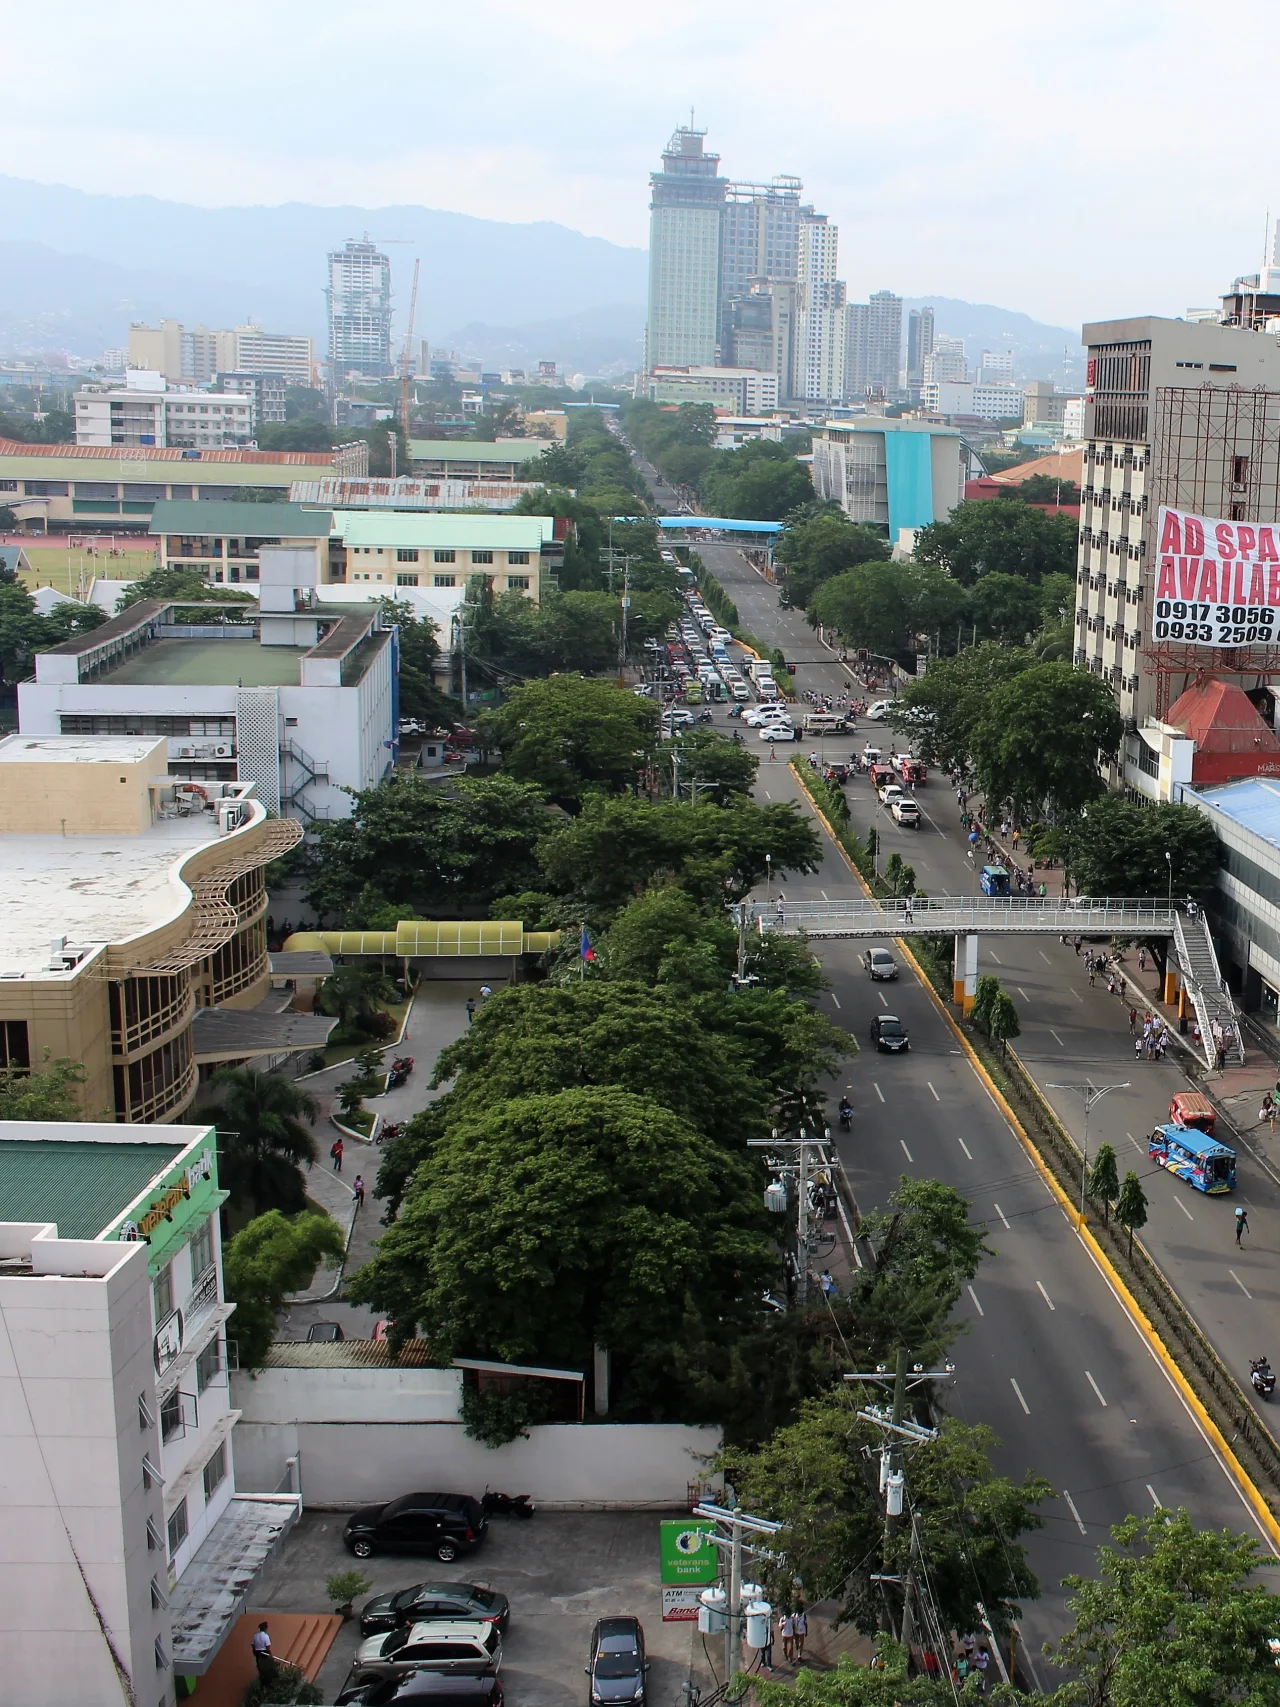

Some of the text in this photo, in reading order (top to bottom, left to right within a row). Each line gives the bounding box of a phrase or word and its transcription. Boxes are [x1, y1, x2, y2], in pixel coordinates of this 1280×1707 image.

[1160, 511, 1204, 556] AD
[1157, 600, 1210, 622] 0917
[1216, 605, 1274, 625] 3056
[1156, 620, 1213, 642] 0933
[1218, 625, 1272, 643] 2509
[184, 1148, 213, 1190] bank
[667, 1559, 710, 1567] veterans
[677, 1565, 701, 1574] bank
